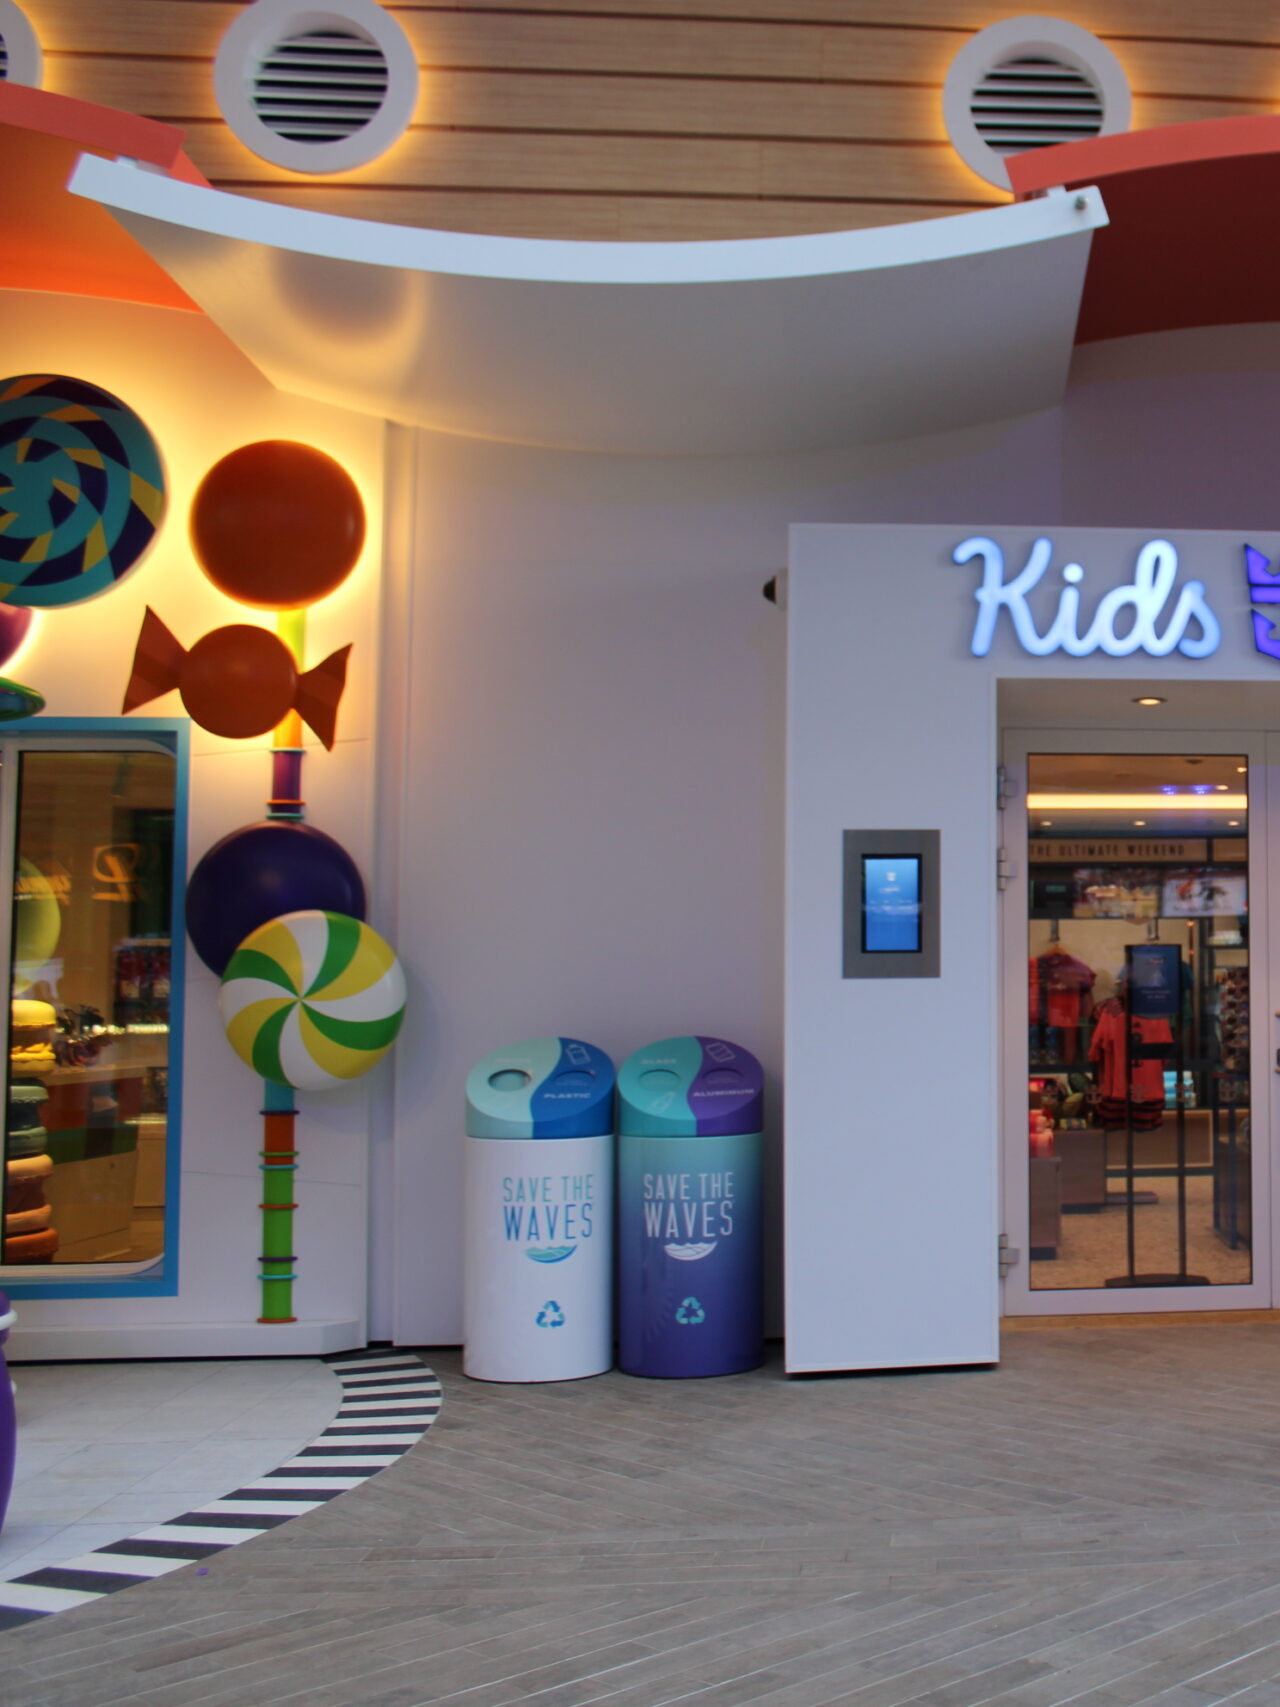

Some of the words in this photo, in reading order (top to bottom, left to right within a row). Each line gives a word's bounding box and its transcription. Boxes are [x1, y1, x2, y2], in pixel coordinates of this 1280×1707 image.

[952, 537, 1222, 658] Kids
[503, 1176, 552, 1203] SAVE
[560, 1174, 594, 1201] THE
[643, 1173, 690, 1200] SAVE
[698, 1172, 735, 1198] THE
[503, 1203, 593, 1241] WAVES
[643, 1200, 734, 1239] WAVES
